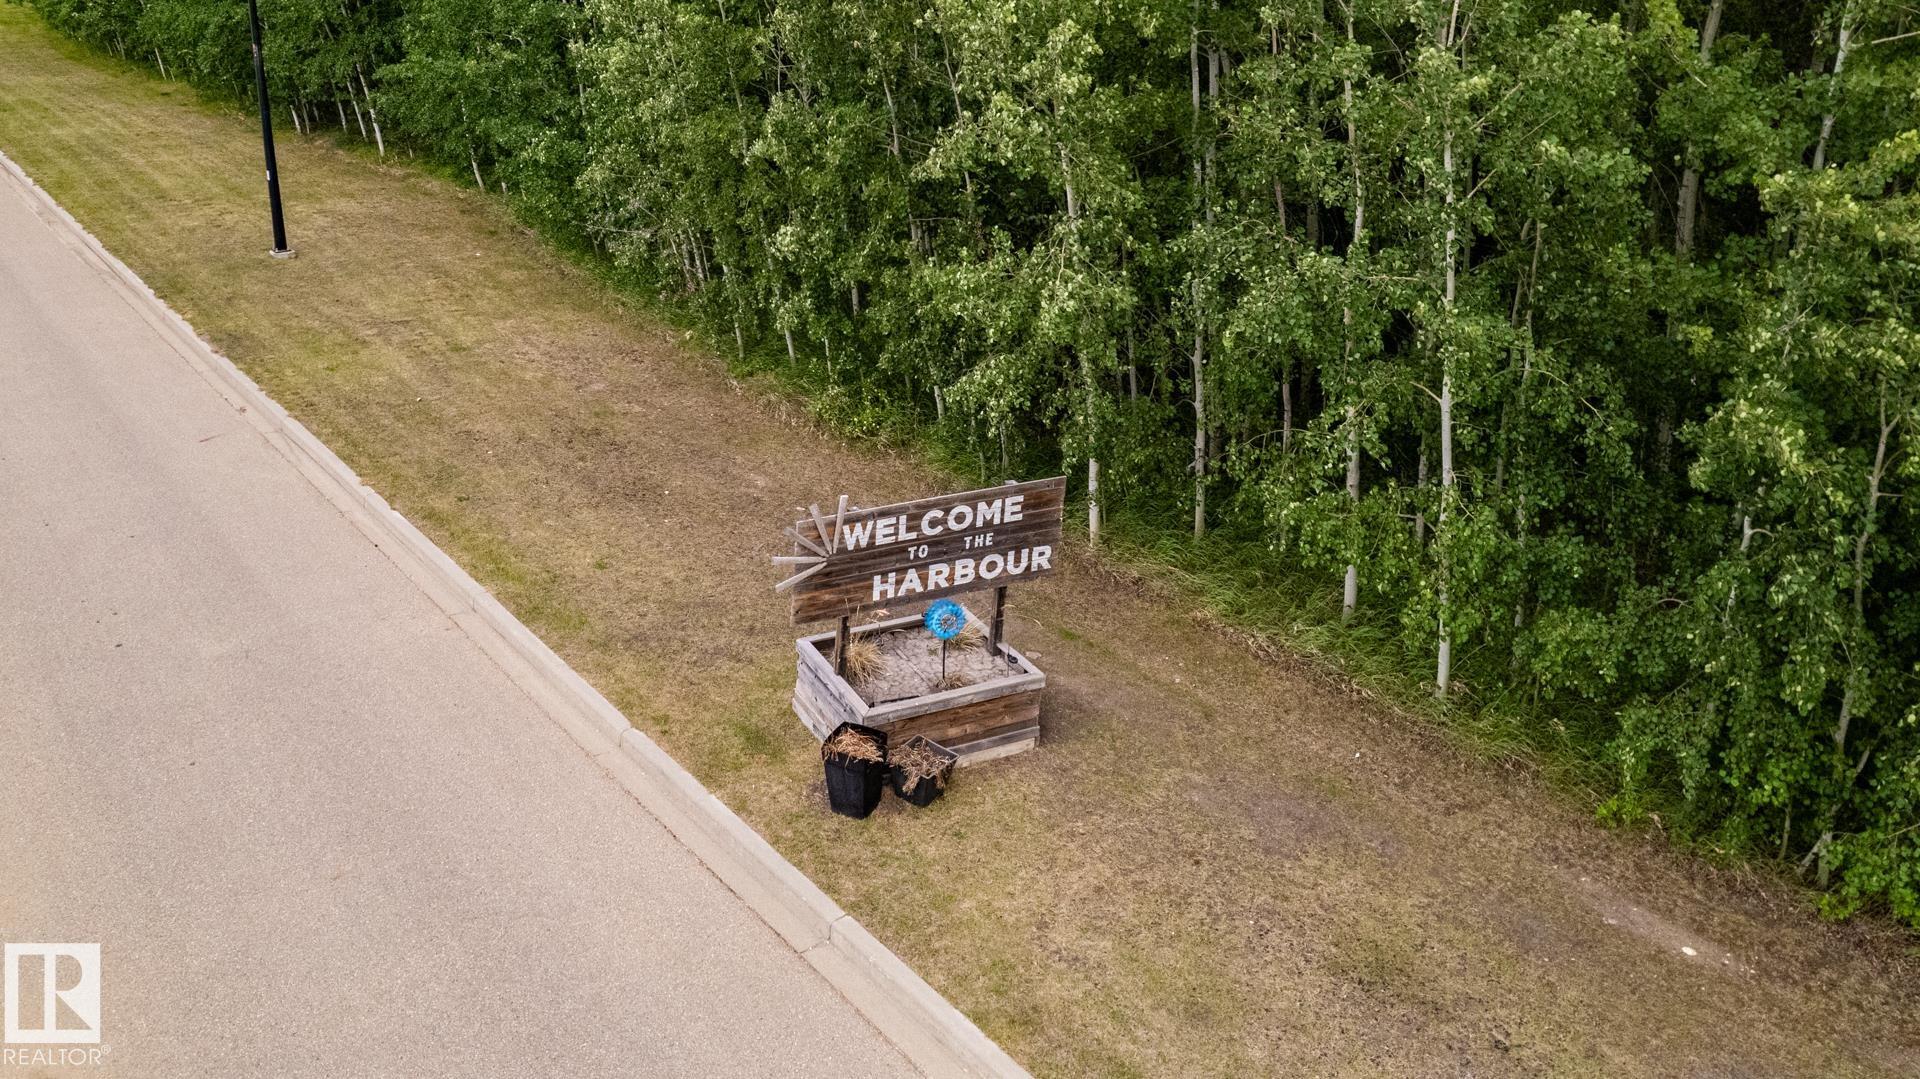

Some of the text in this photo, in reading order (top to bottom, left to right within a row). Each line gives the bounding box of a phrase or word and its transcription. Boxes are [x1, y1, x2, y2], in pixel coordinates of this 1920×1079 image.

[843, 495, 1024, 551] WELCOME
[907, 532, 994, 560] TO THE
[872, 545, 1052, 601] HARBOUR
